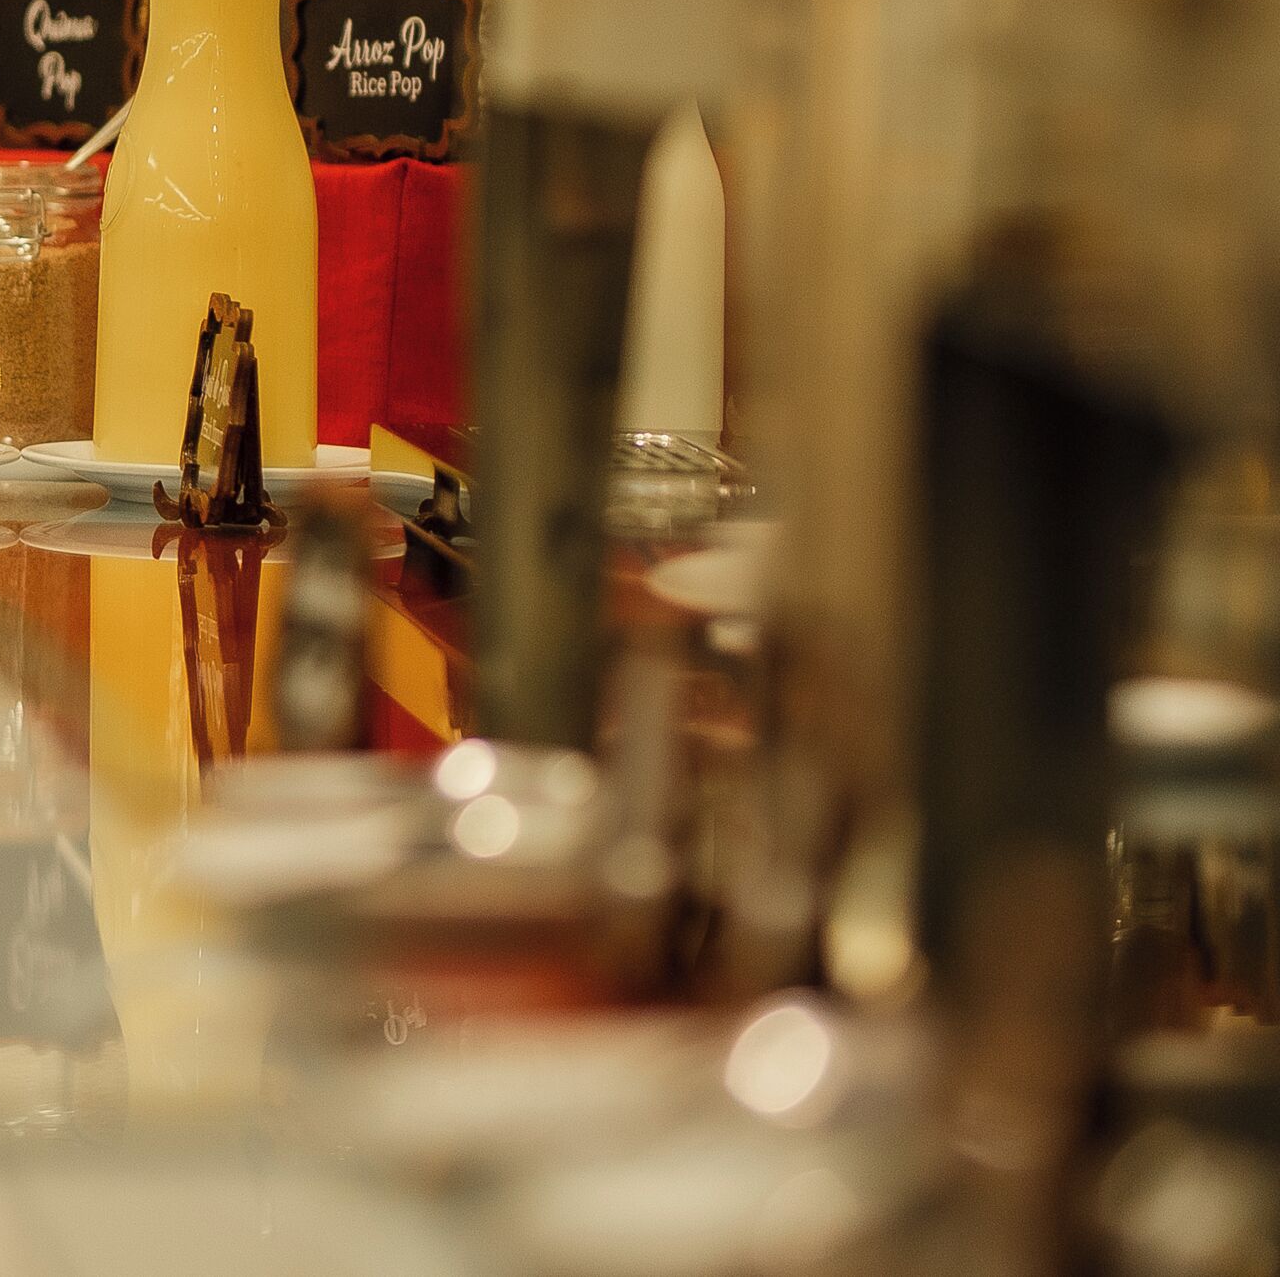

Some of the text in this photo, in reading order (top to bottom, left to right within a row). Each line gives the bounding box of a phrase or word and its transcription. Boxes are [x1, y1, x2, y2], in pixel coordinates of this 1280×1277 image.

[325, 15, 446, 82] Arroz Pop
[350, 70, 423, 102] Rice Pop
